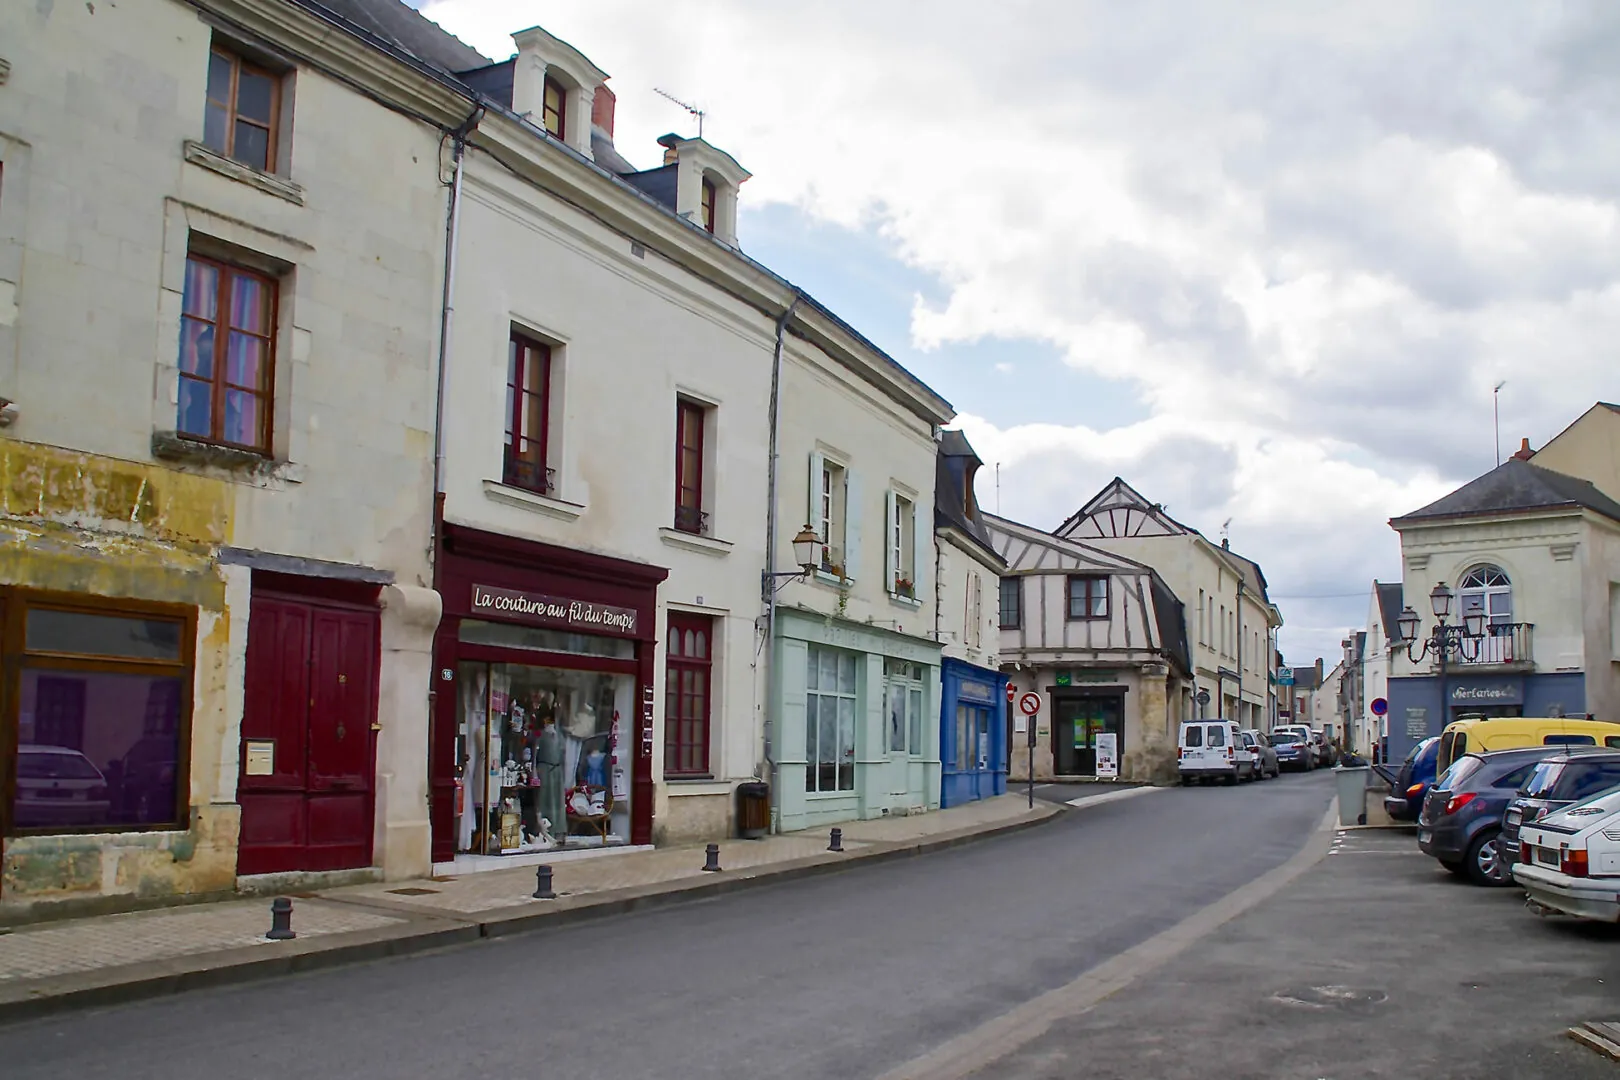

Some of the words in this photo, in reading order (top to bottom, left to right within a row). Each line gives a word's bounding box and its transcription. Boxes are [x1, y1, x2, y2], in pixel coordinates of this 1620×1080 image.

[475, 587, 494, 607] La
[495, 595, 547, 615] couture
[547, 604, 567, 618] au
[568, 601, 584, 623] fil
[584, 604, 603, 623] du
[603, 609, 635, 633] temps
